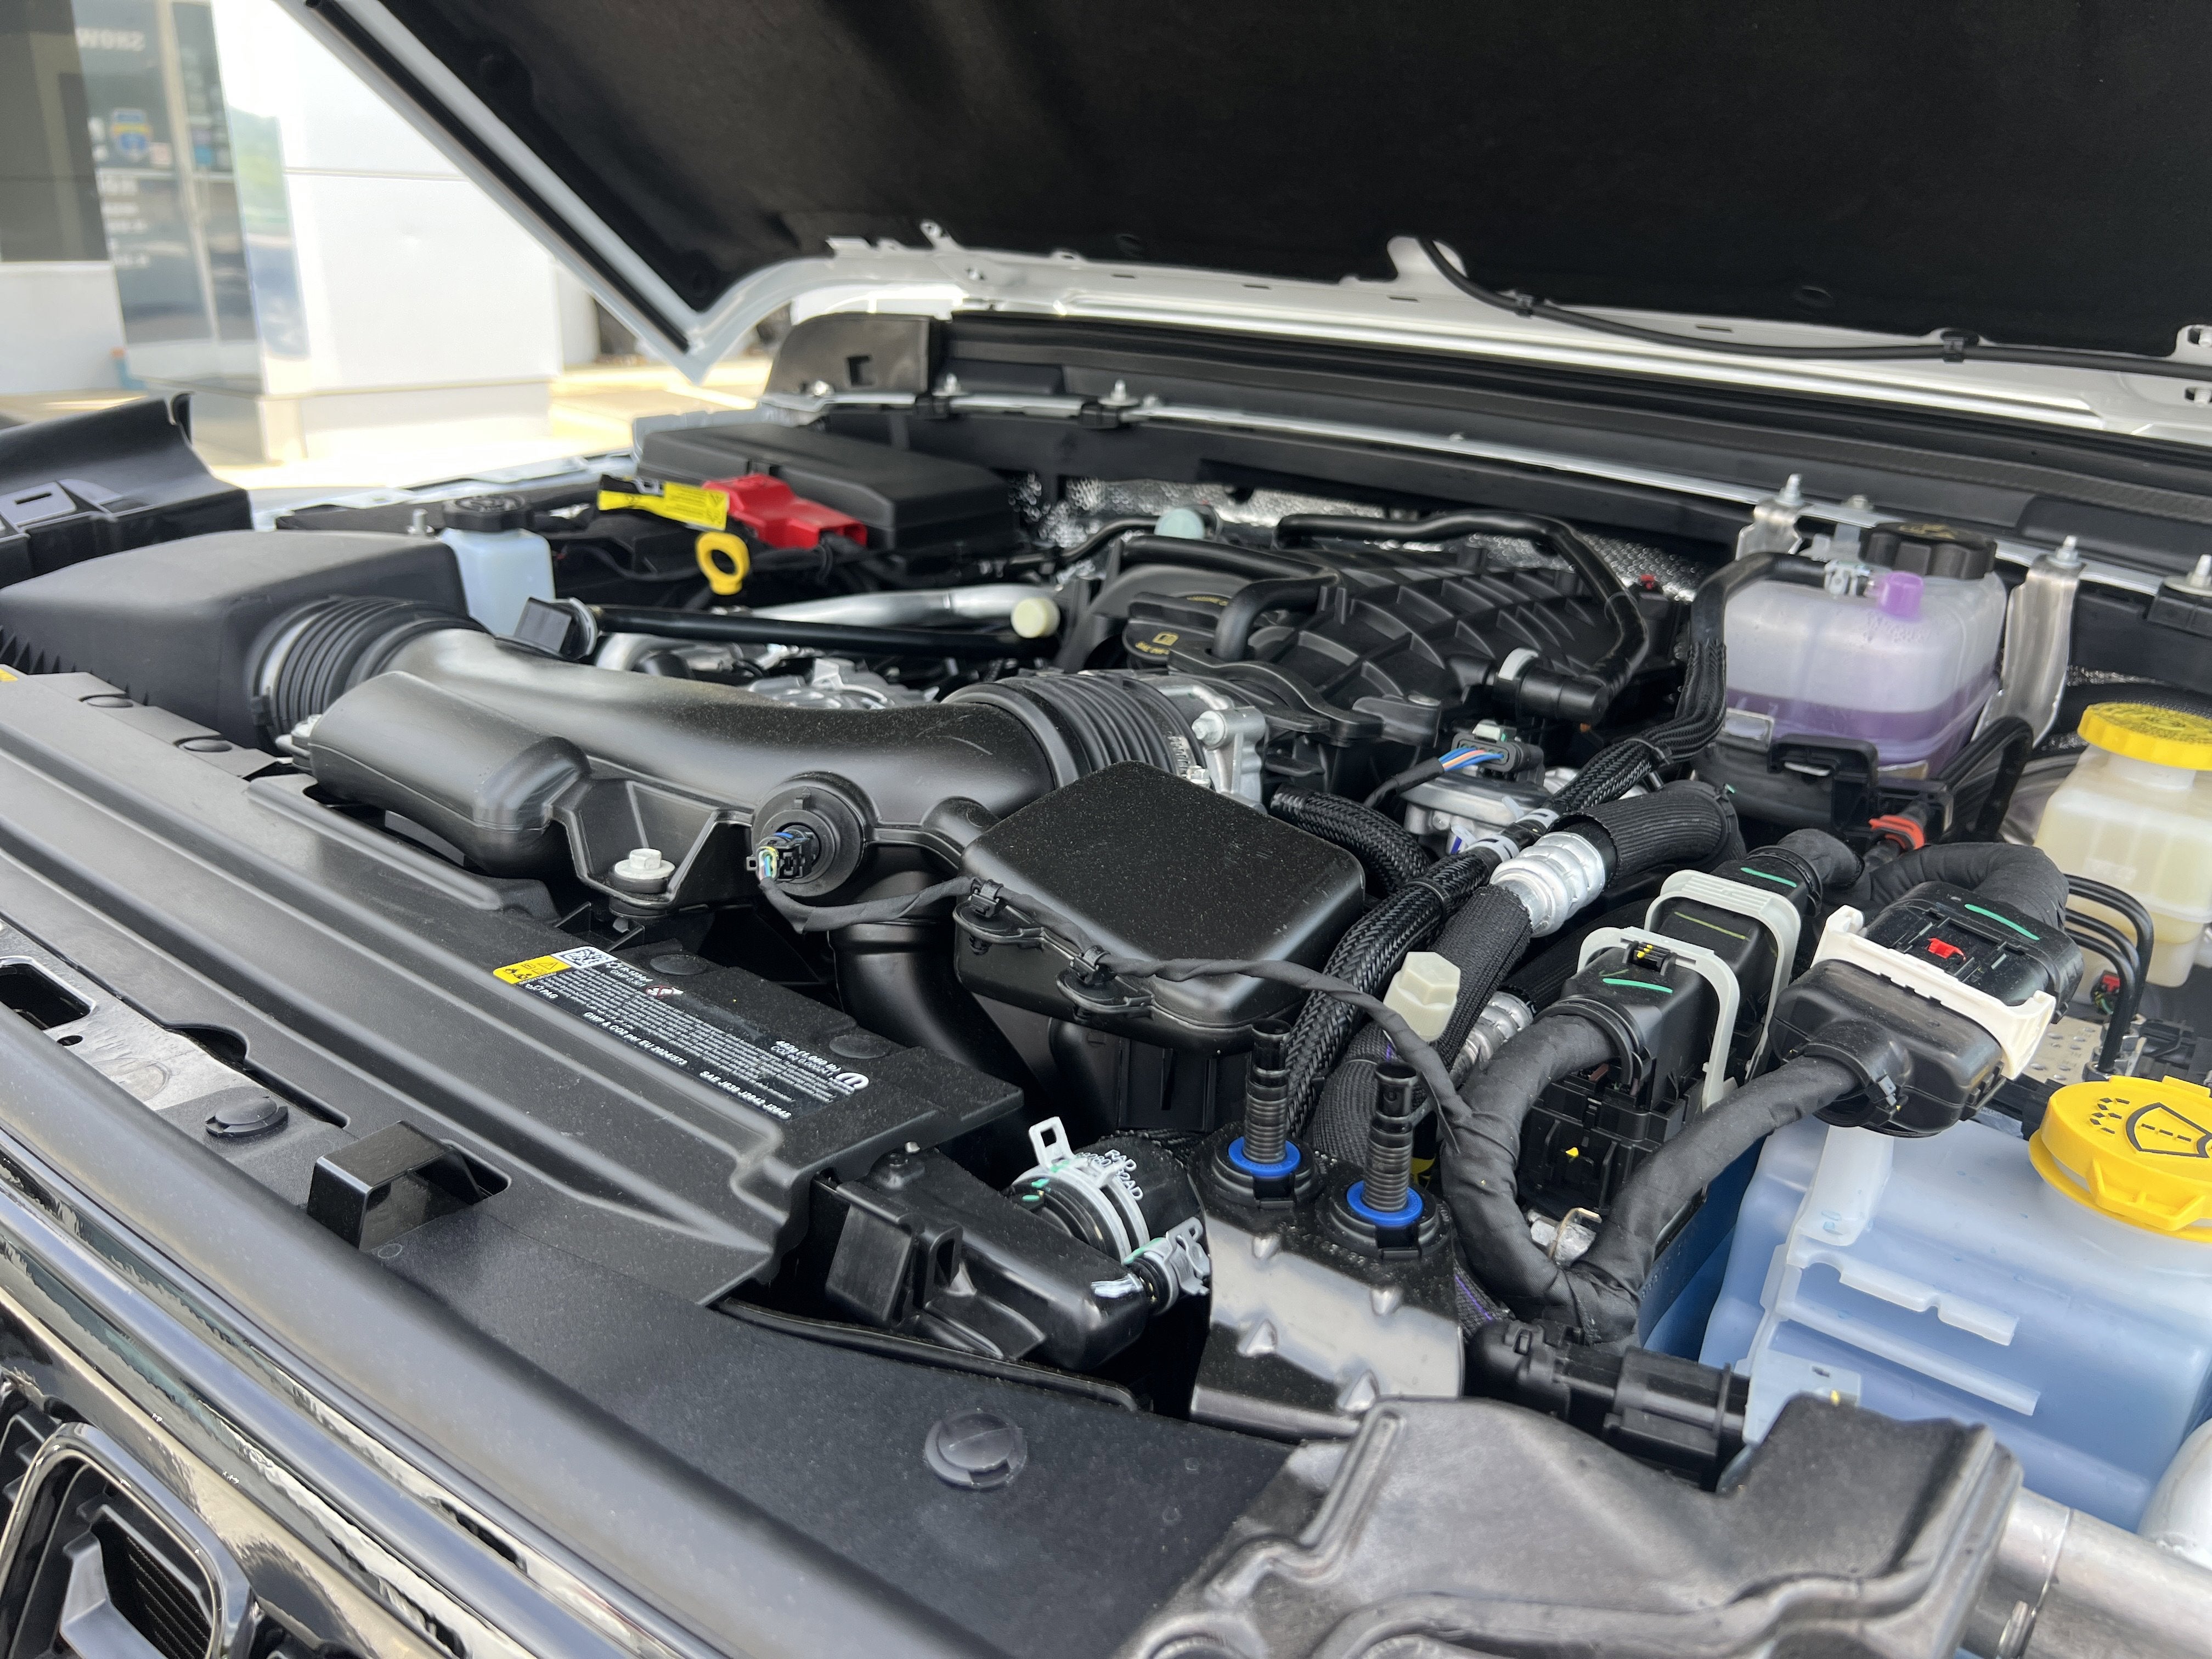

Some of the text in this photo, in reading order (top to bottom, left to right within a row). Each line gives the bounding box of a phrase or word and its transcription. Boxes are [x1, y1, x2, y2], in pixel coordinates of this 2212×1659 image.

[539, 989, 558, 998] PAG
[583, 1012, 605, 1024] GWP
[623, 1034, 642, 1044] per
[639, 1040, 655, 1049] EU
[699, 1071, 792, 1120] SAE J639 J2842 J2845
